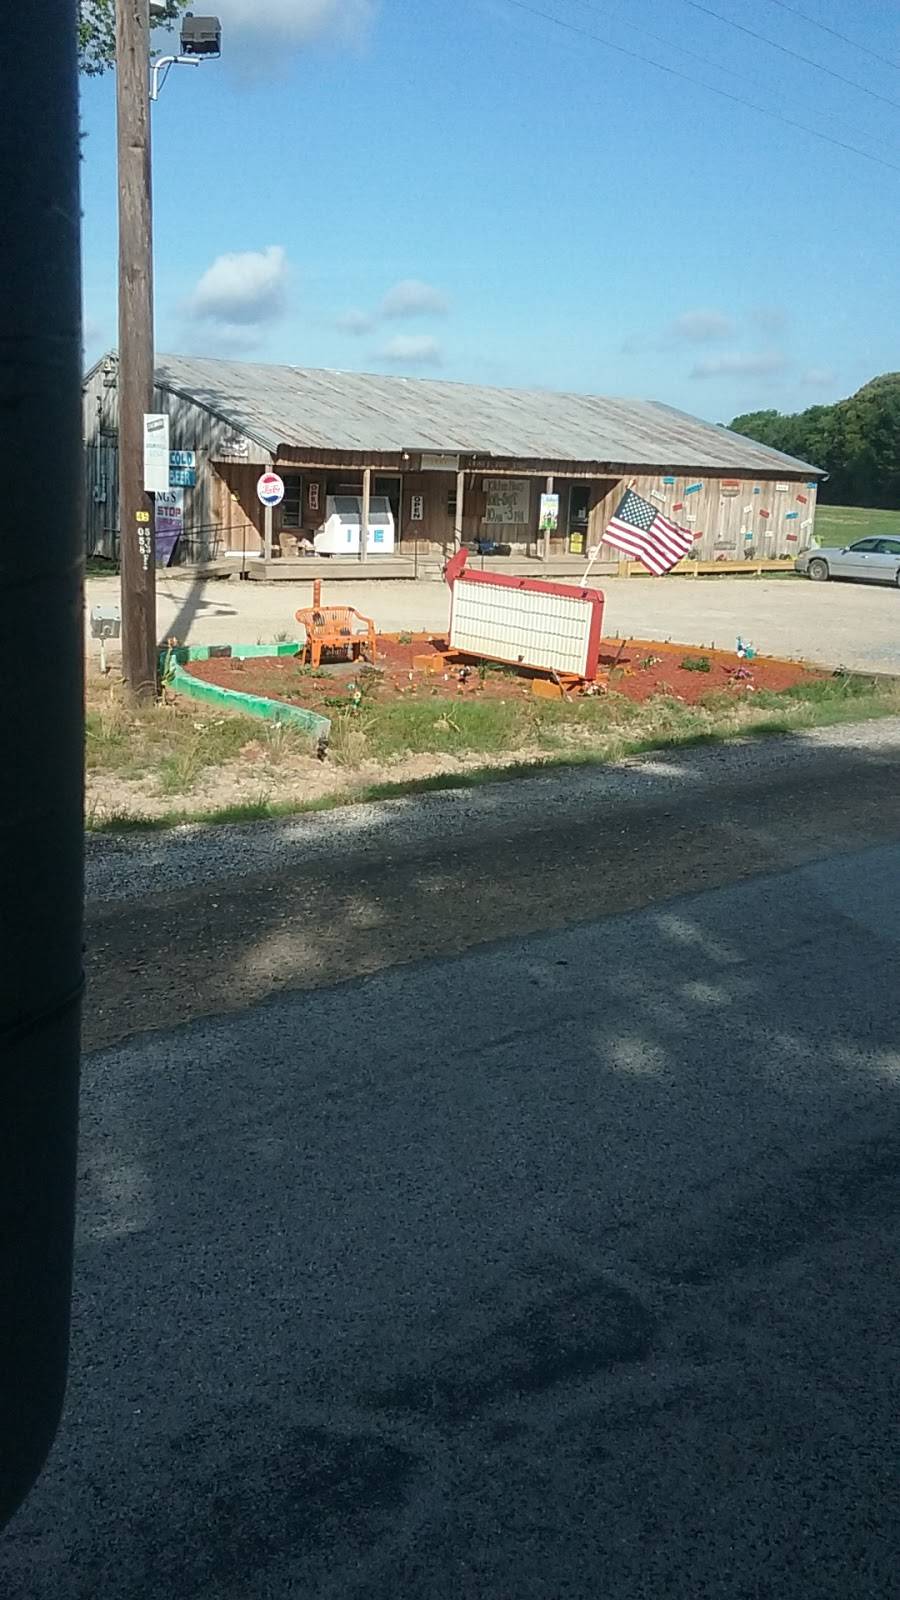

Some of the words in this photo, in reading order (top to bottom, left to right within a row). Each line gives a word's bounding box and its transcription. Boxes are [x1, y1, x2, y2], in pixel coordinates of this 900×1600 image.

[170, 451, 192, 465] COLD
[169, 470, 190, 485] BEER
[310, 484, 318, 509] OPEN
[157, 506, 181, 517] STOP
[413, 496, 421, 519] OPEN
